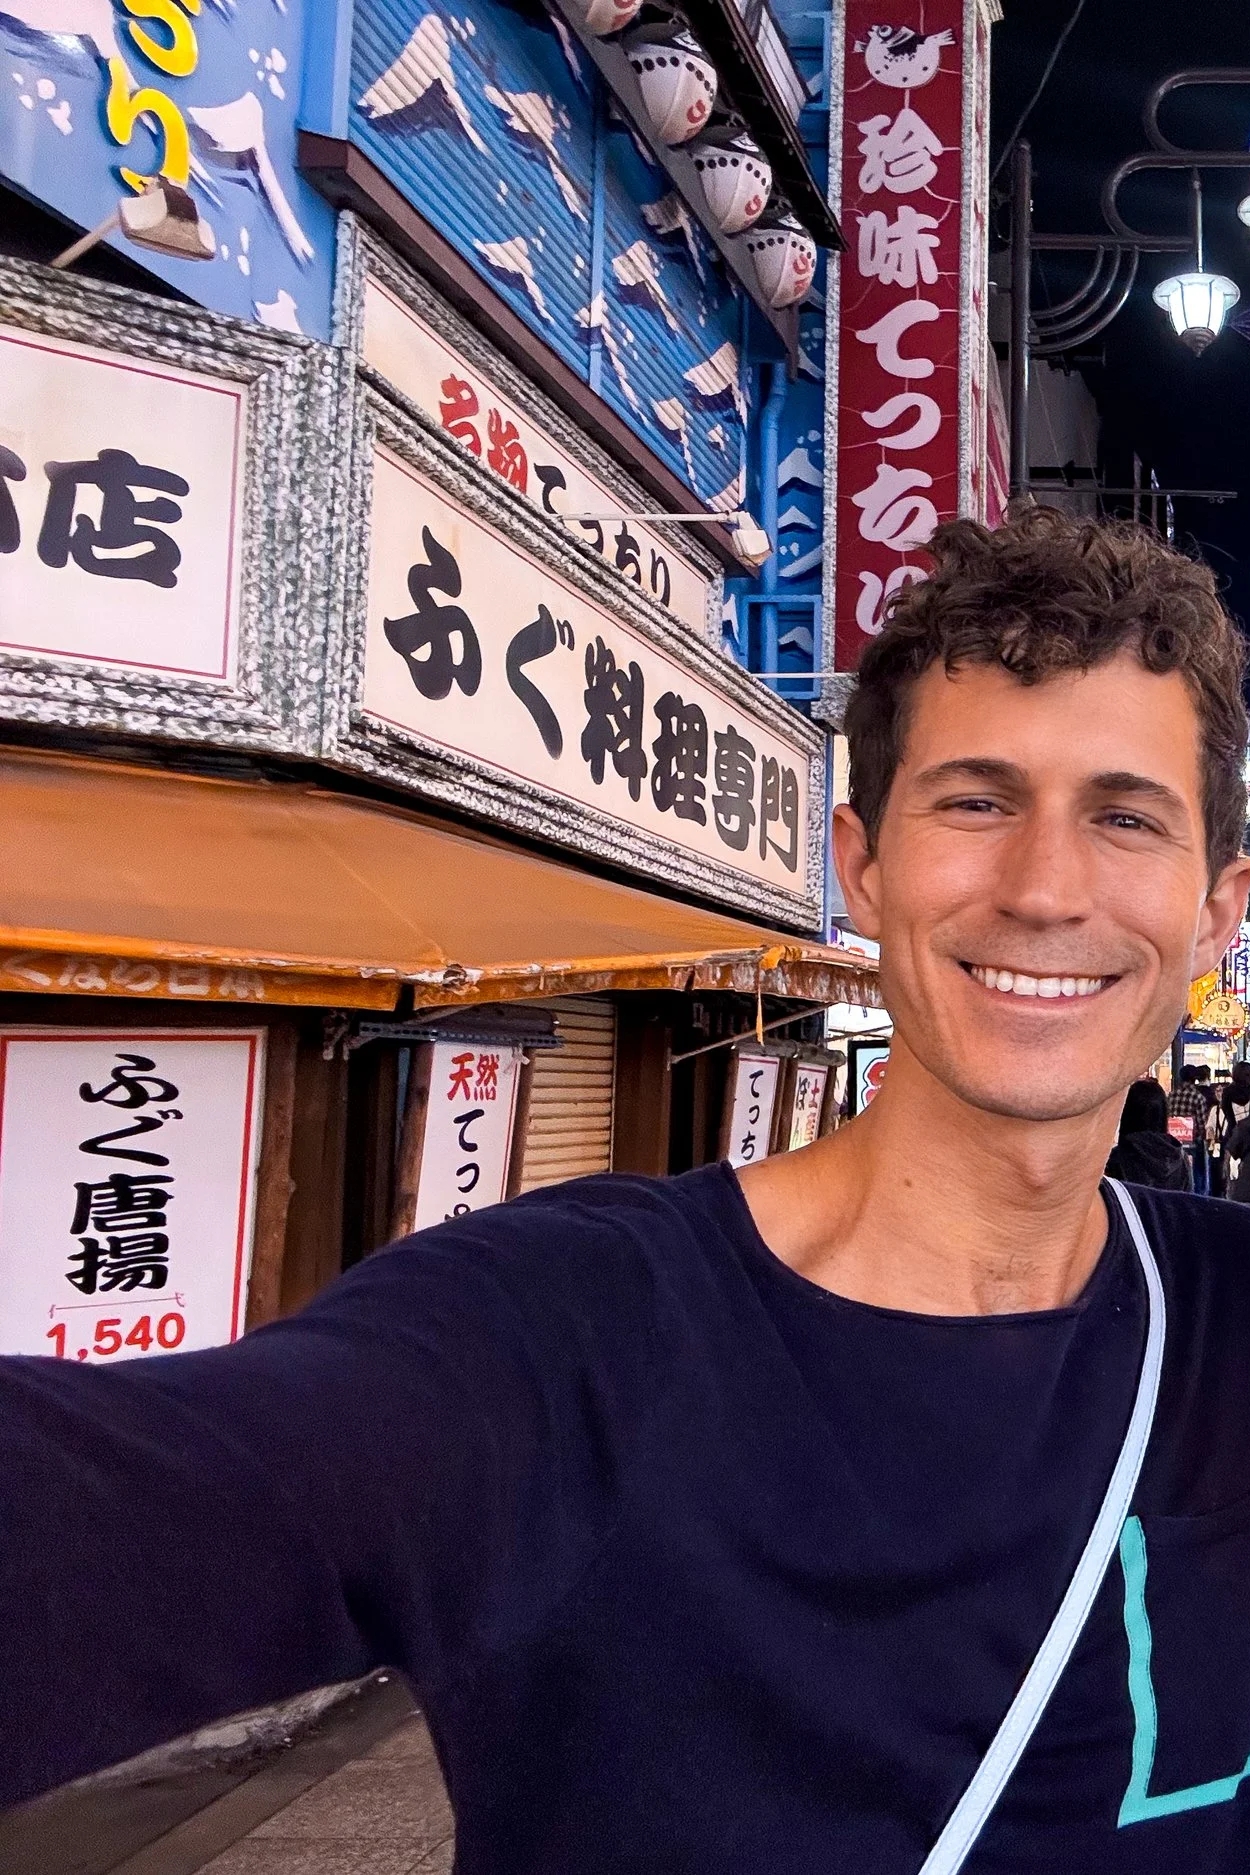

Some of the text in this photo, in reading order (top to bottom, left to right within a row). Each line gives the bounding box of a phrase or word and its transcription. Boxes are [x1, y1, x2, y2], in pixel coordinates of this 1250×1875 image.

[439, 373, 528, 496] 名物
[0, 448, 187, 589] 店
[447, 1052, 500, 1101] 天然
[65, 1053, 184, 1295] ふぐ唐揚
[47, 1312, 185, 1361] 1,540
